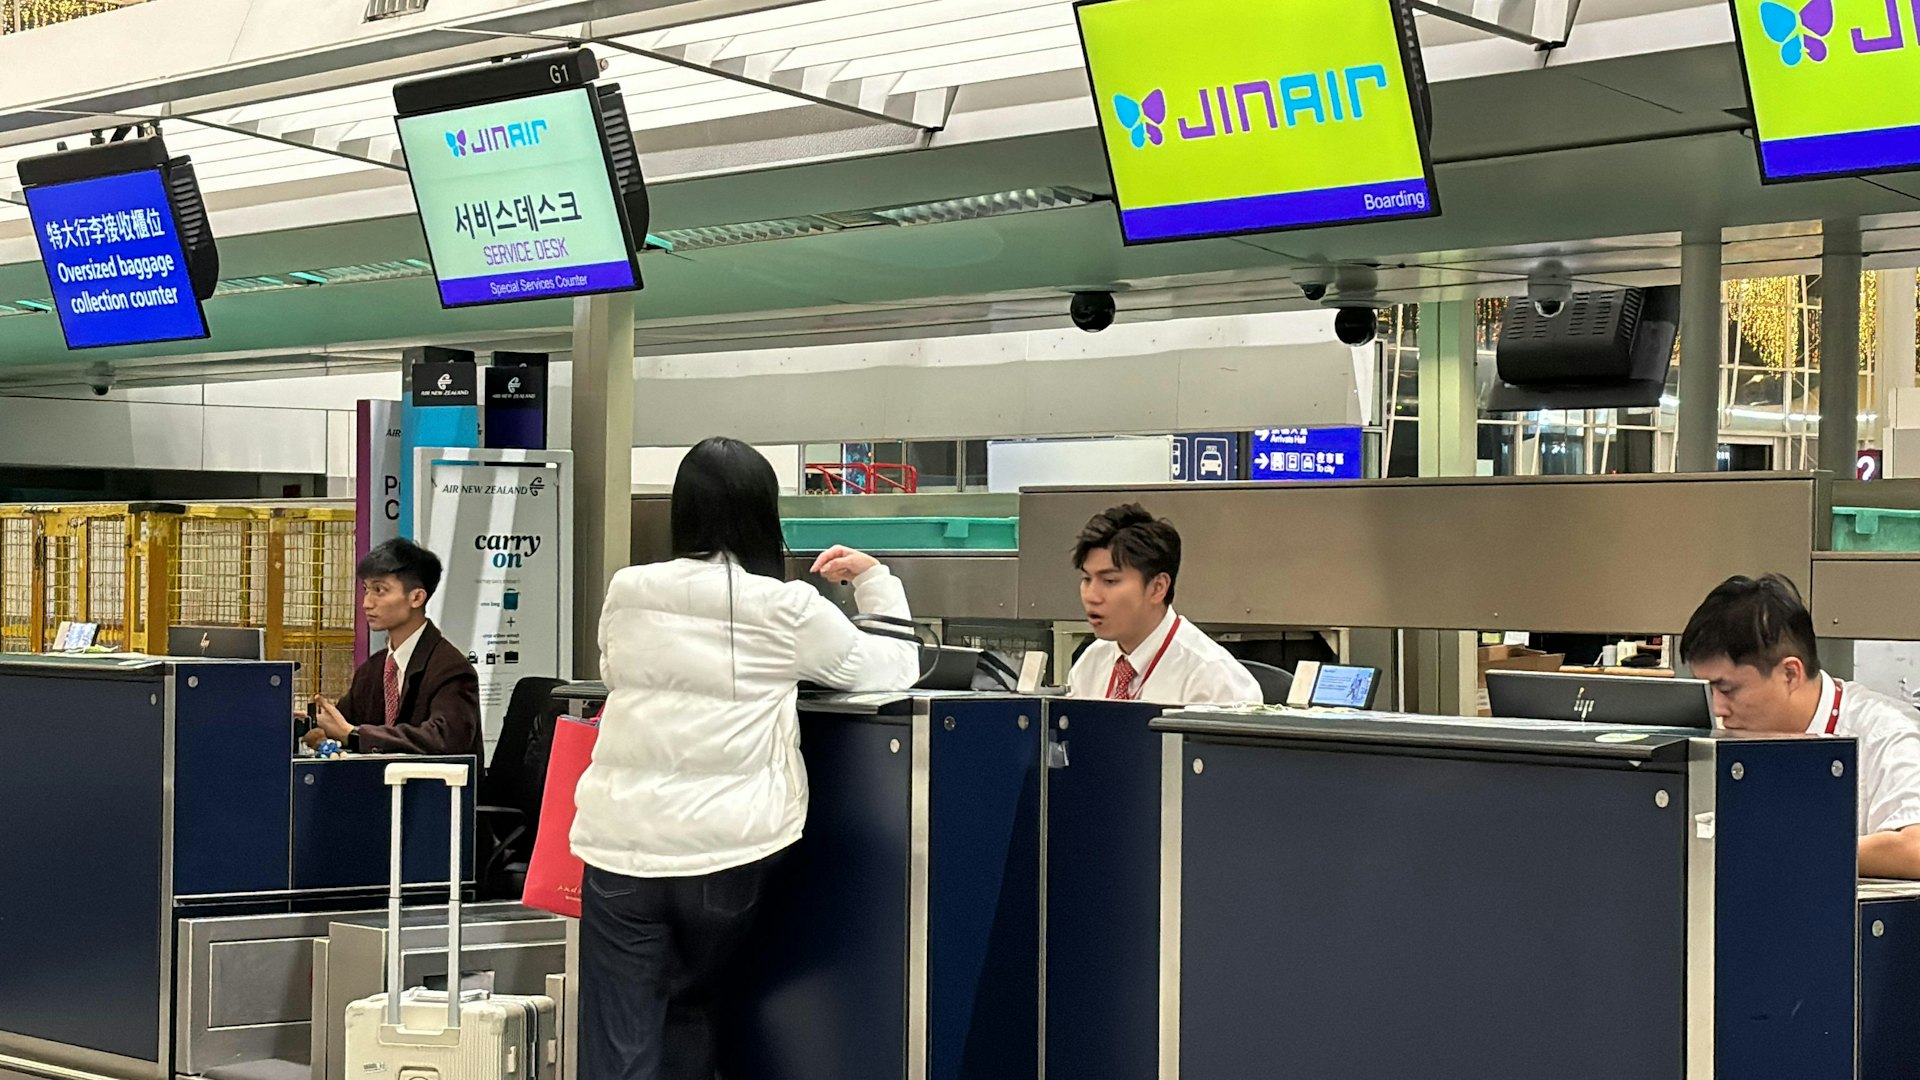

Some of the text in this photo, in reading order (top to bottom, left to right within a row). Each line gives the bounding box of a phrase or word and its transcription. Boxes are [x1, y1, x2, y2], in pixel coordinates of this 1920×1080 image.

[550, 65, 569, 84] G1
[1363, 189, 1426, 211] Boarding
[455, 191, 583, 239] 서비스데스크
[45, 207, 166, 250] 特大行李接收櫃位
[483, 237, 569, 266] SERVICE DESK
[57, 253, 175, 283] Oversized baggage
[489, 274, 588, 296] Special Services Counter
[71, 284, 178, 314] collection counter
[386, 428, 401, 438] AIR
[384, 475, 401, 496] P
[442, 484, 528, 495] AIR NEW ZEALAND
[474, 533, 541, 558] carry
[492, 552, 523, 569] on
